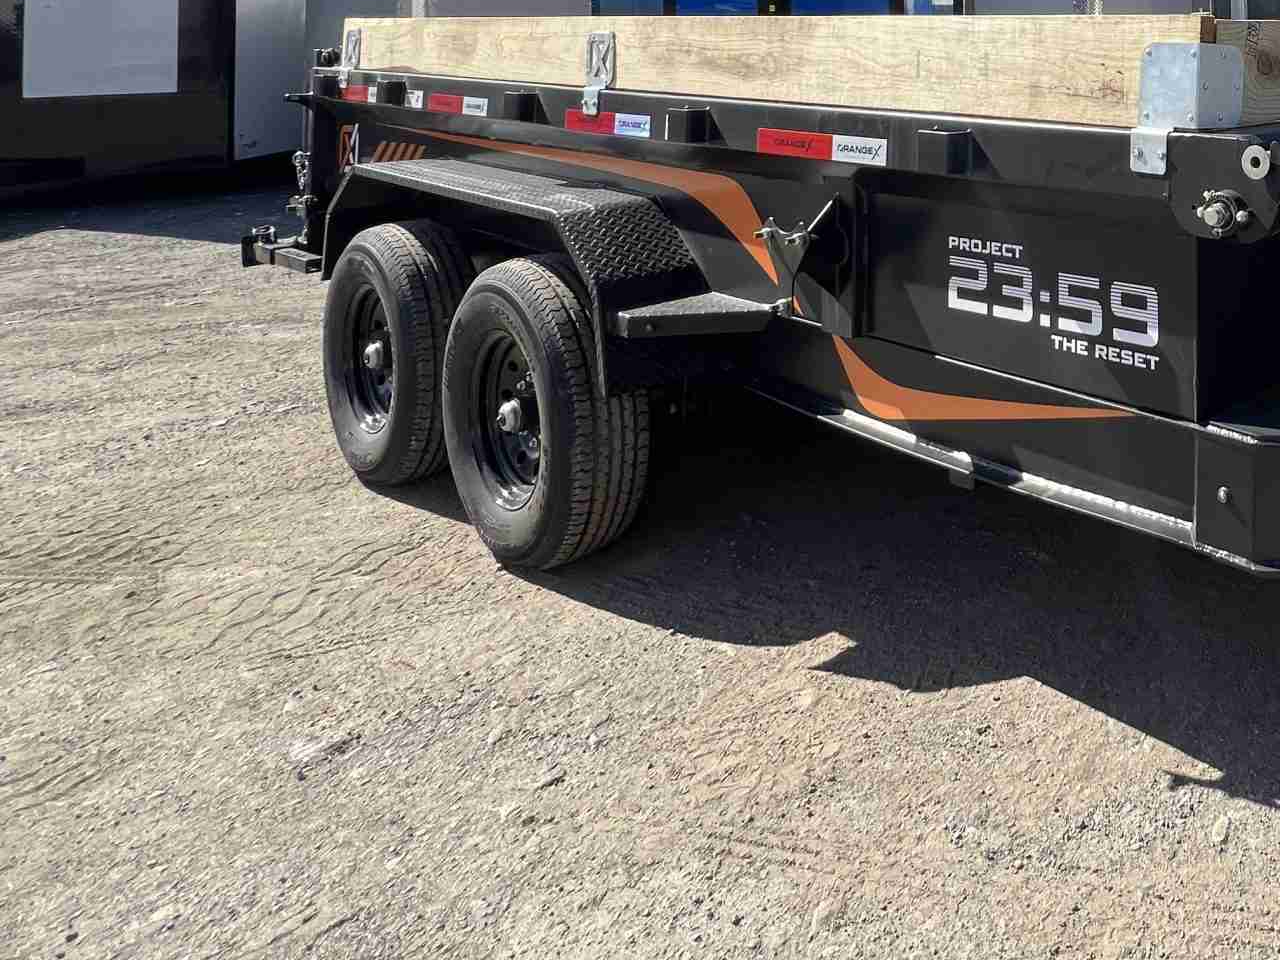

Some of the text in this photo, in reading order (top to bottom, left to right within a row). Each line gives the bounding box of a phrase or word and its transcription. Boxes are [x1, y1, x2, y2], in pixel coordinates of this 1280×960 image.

[836, 143, 883, 161] ORANGEX
[948, 235, 1024, 259] PROJECT
[947, 254, 1159, 348] 23:59
[1051, 334, 1160, 371] THE RESET
